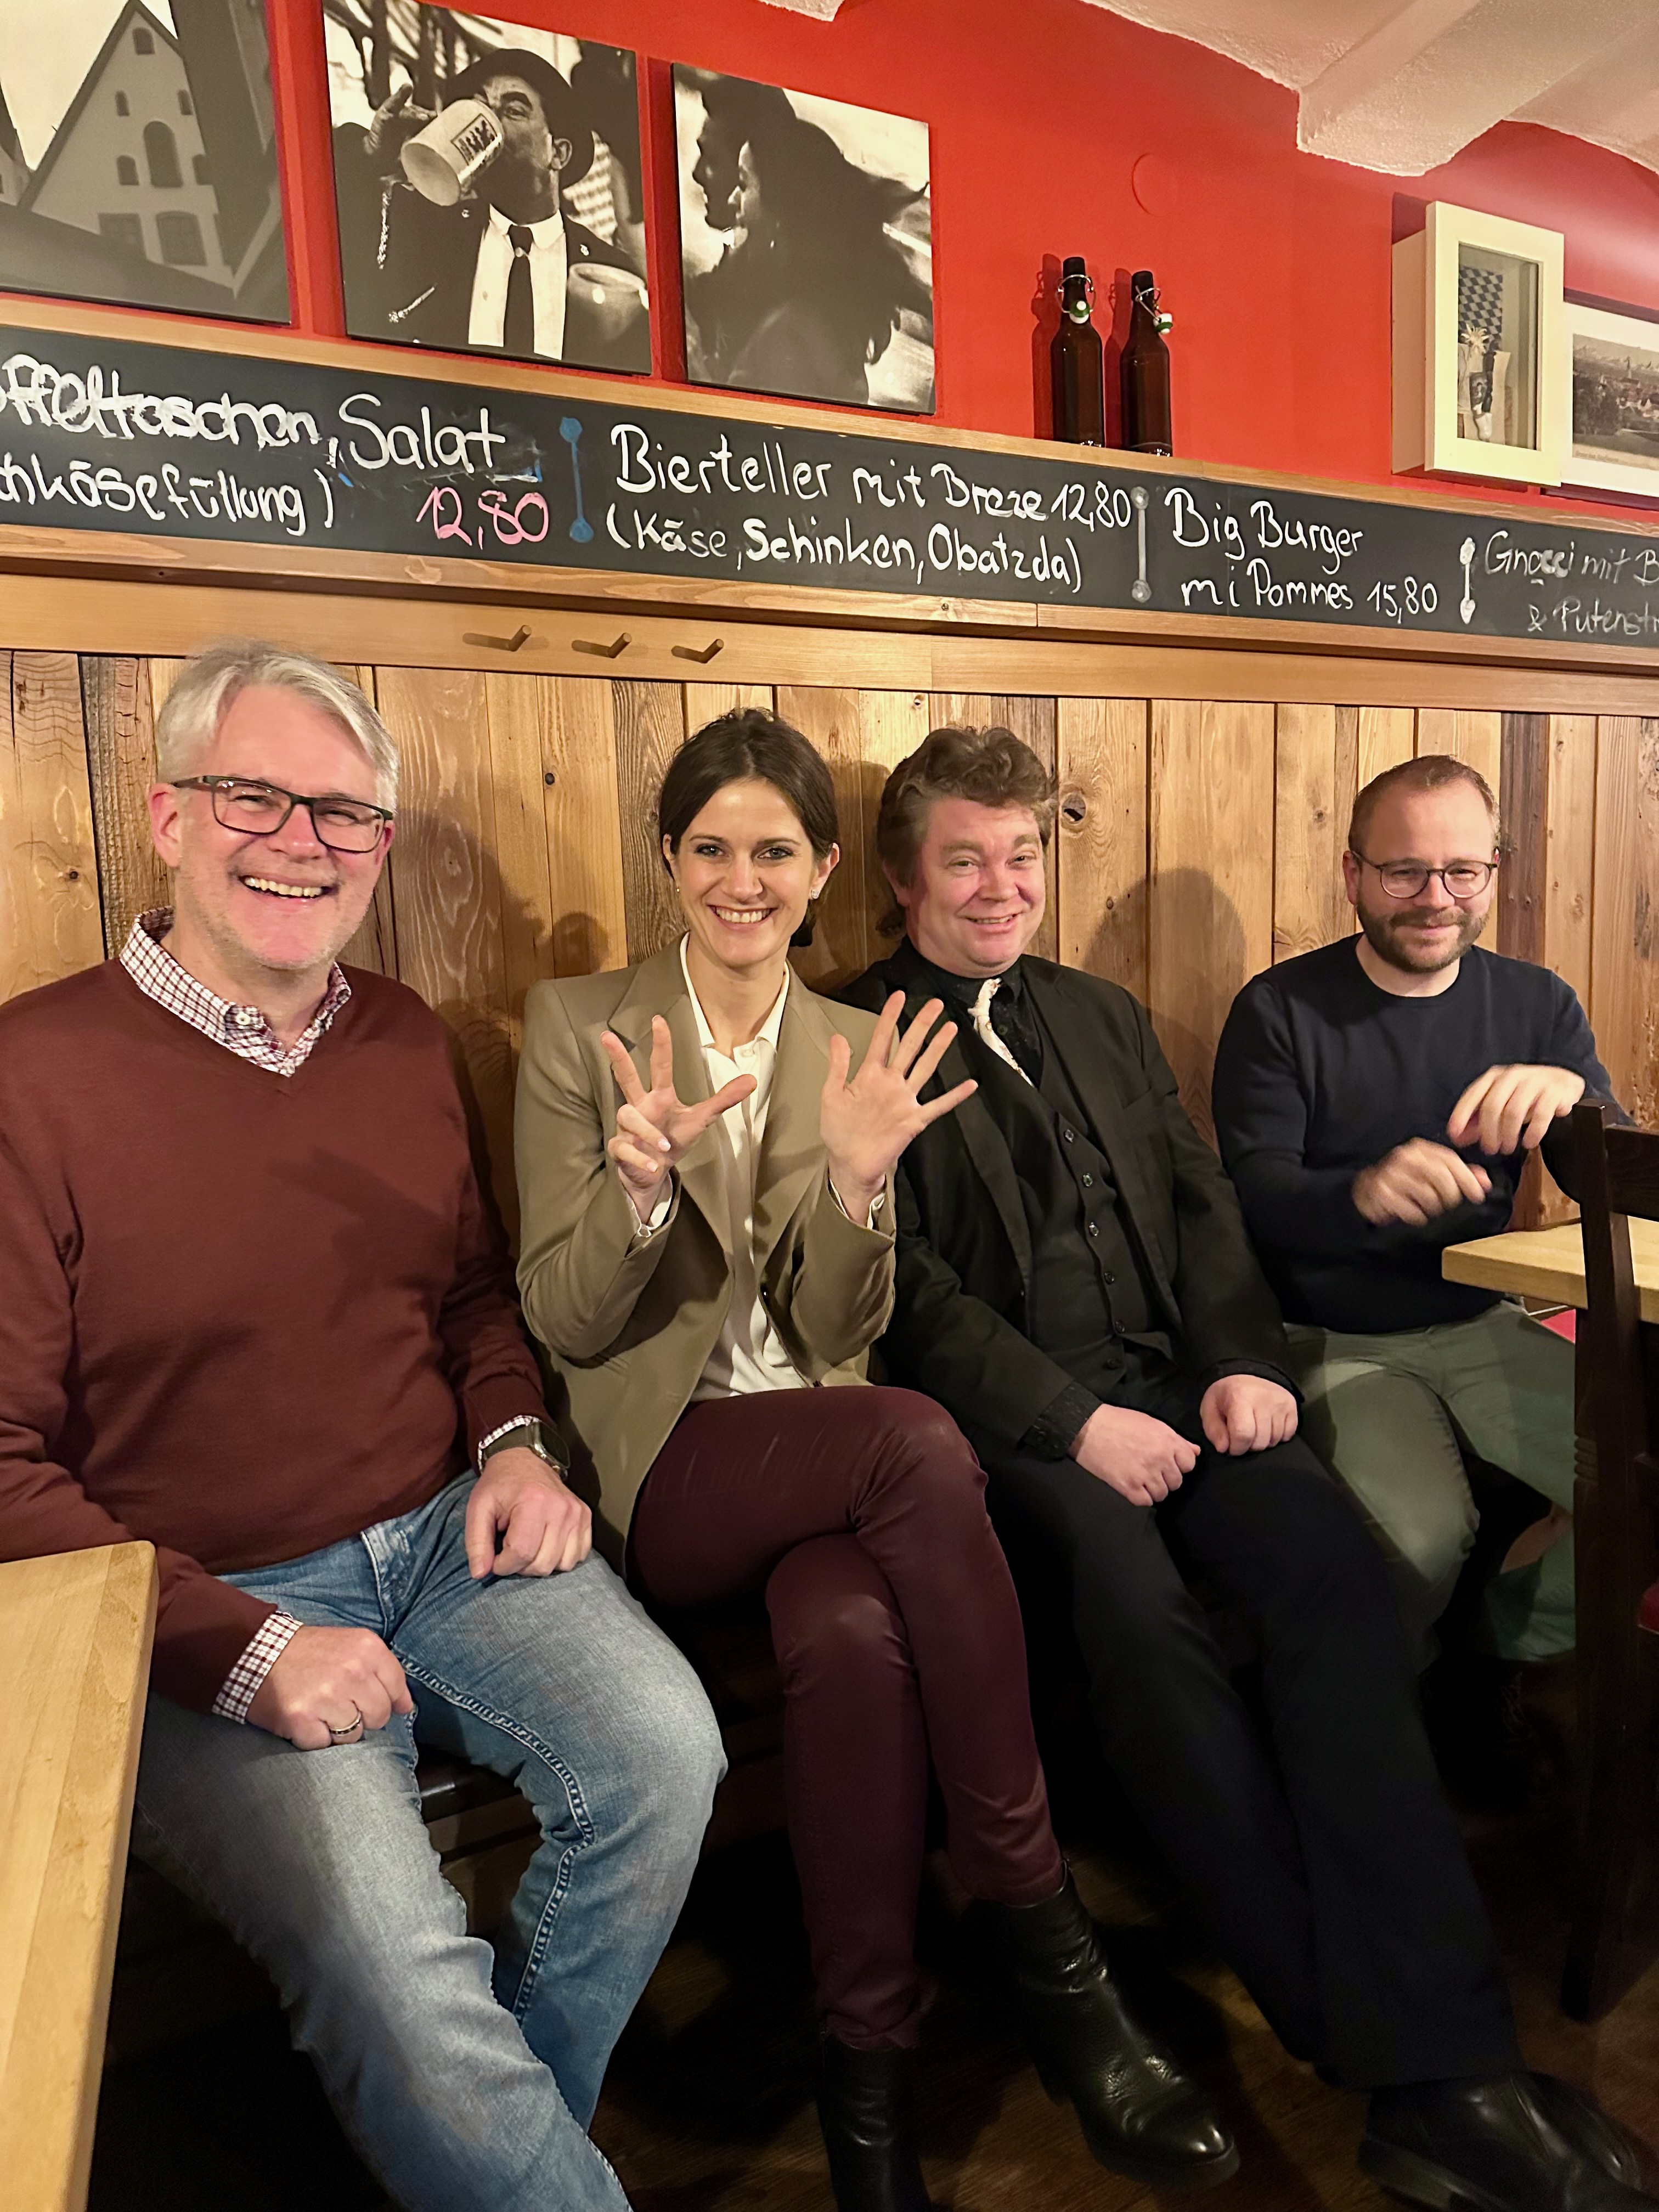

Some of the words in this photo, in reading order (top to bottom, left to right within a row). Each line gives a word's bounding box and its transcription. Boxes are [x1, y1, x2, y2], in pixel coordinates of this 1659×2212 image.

[0, 354, 338, 469] ffeltaschen,
[338, 393, 505, 473] Salat
[610, 424, 832, 500] Bierteller
[853, 459, 926, 507] mit
[930, 462, 1048, 521] Breze
[1051, 480, 1132, 532] 12,80
[416, 486, 549, 550] 12,80
[1164, 487, 1245, 561] Big
[1250, 500, 1363, 575] Burger
[1181, 566, 1240, 607] mi
[1246, 558, 1354, 610] Pommes
[1366, 576, 1438, 624] 15,80
[1581, 548, 1632, 584] mit
